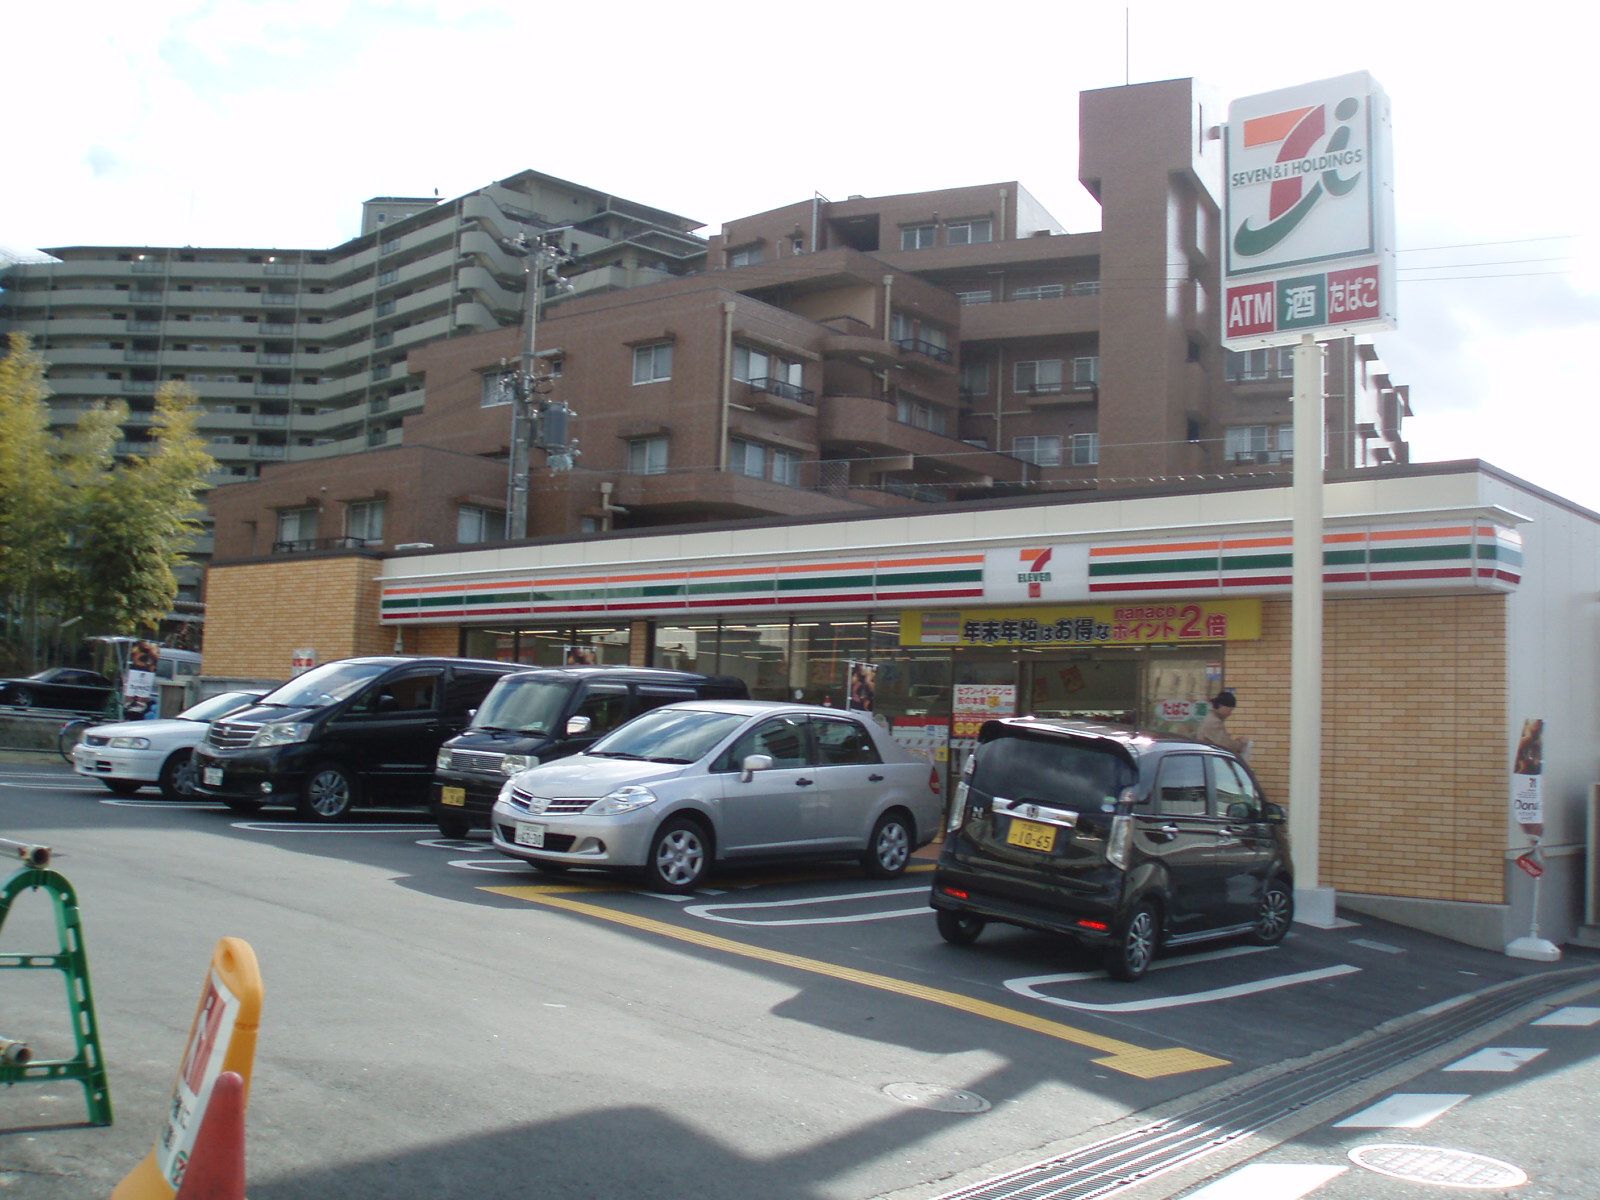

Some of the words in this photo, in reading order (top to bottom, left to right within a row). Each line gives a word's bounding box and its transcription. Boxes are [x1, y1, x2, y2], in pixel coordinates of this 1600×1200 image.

[1291, 148, 1363, 176] HOLDINGS
[1285, 285, 1317, 321] 酒
[1329, 276, 1377, 313] たばこ
[1229, 292, 1272, 328] ATM
[1114, 606, 1177, 620] nanaco
[963, 617, 1109, 643] 年末年始はお得な
[1162, 702, 1190, 717] たばこ
[1019, 831, 1051, 849] 10-65
